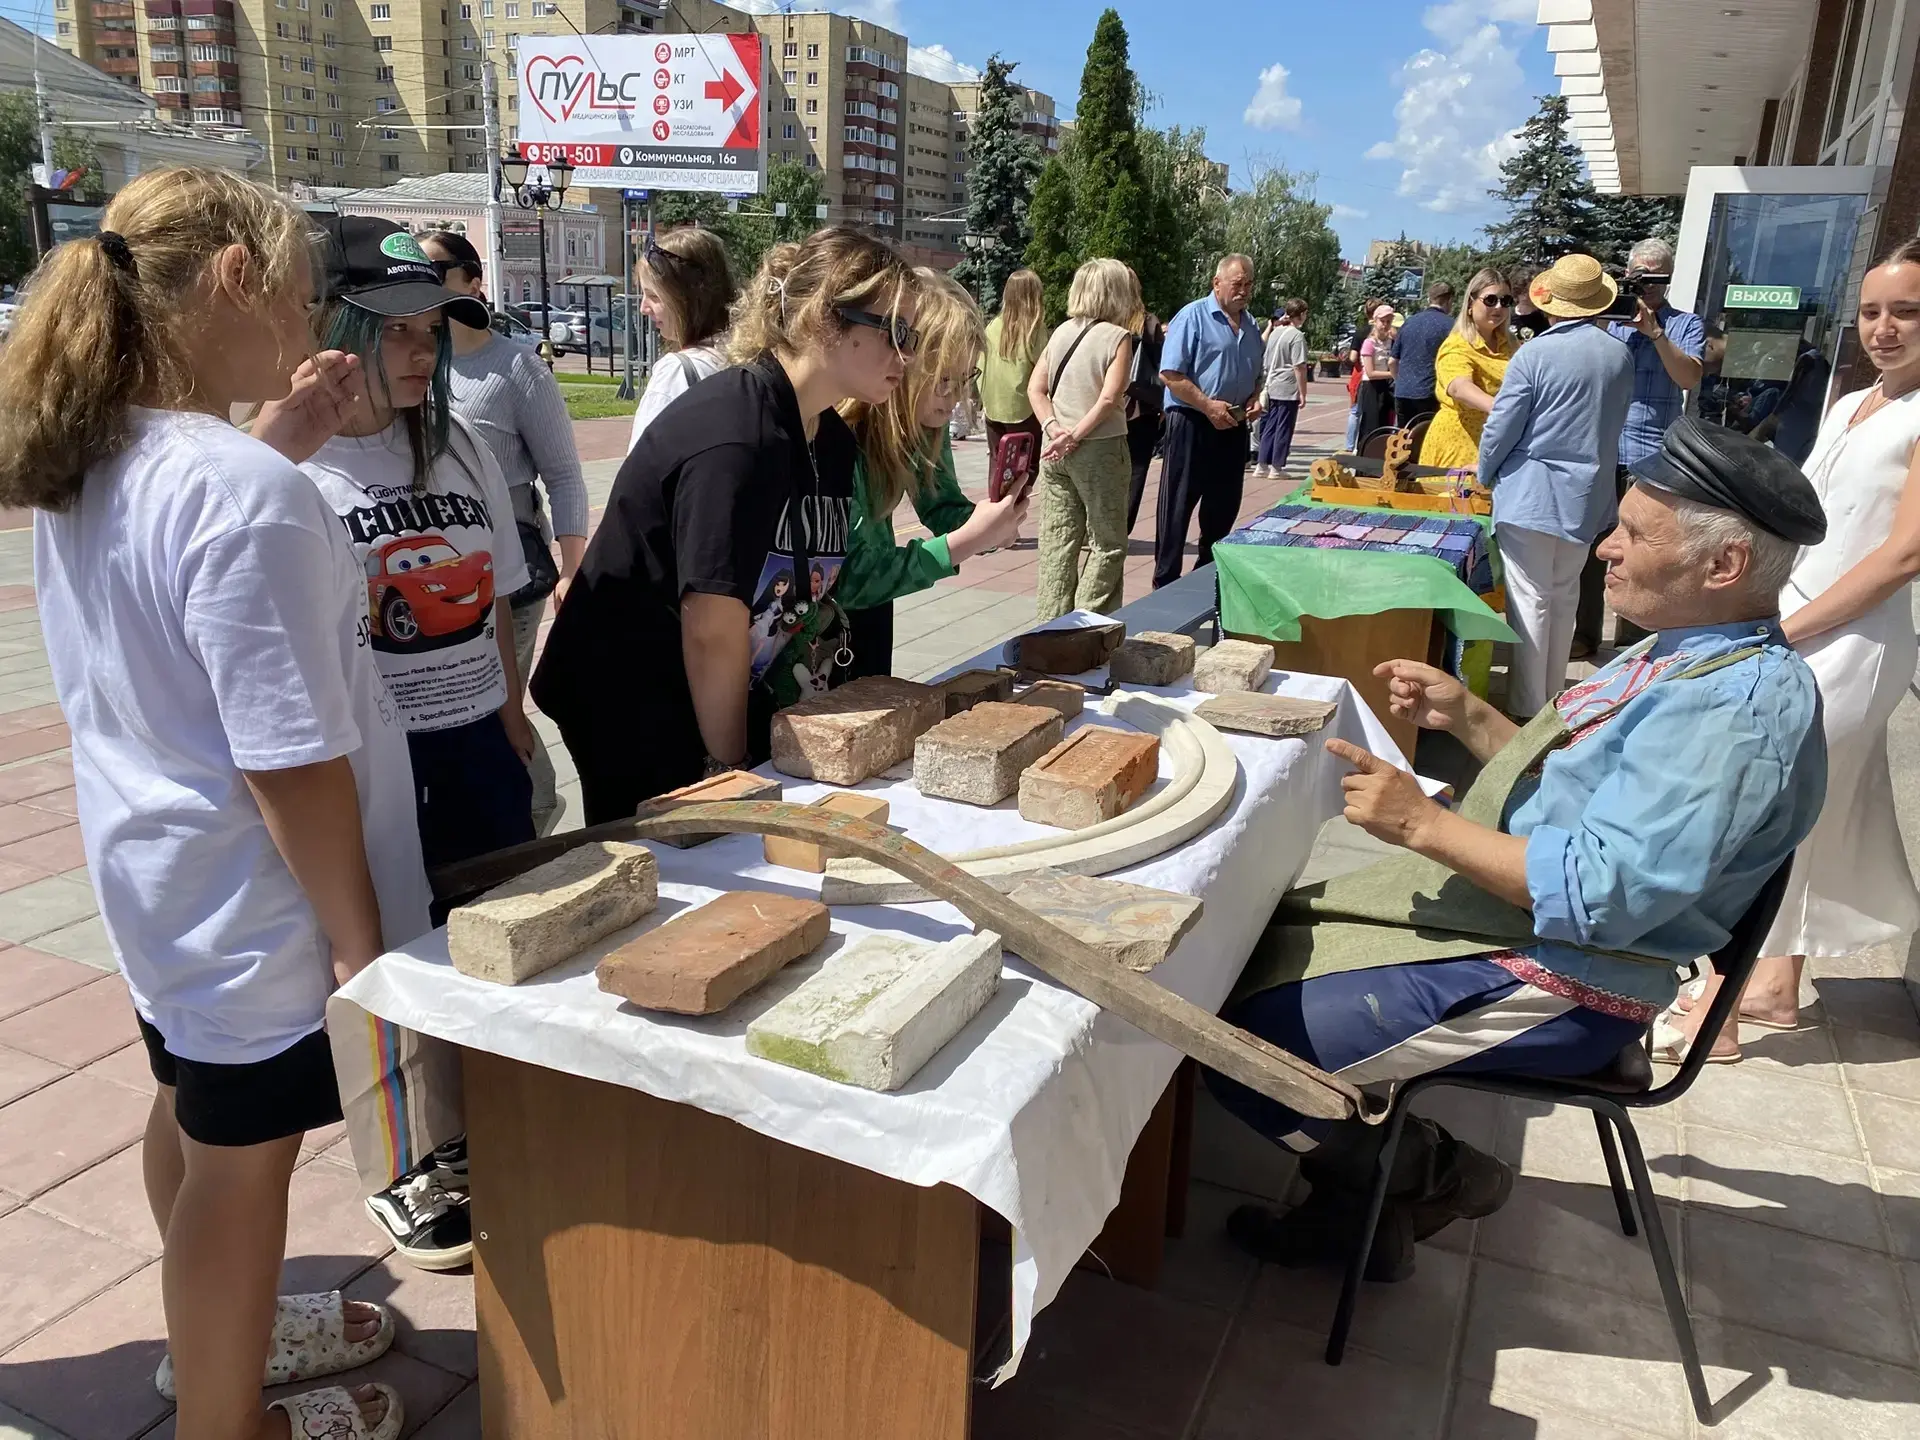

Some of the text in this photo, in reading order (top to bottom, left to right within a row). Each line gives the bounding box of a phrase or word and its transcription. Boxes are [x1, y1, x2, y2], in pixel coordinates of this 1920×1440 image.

[674, 47, 695, 58] МРТ
[674, 74, 685, 84] КТ
[539, 71, 641, 110] ПУЛЬС
[673, 100, 693, 110] УЗИ
[617, 113, 635, 121] ЦЕНТР
[542, 145, 601, 163] 501-501
[635, 150, 737, 165] Коммунальная, 16а
[615, 169, 657, 182] НЕОБХОДИМА
[659, 170, 707, 183] КОНСУЛЬТАЦИЯ
[708, 172, 756, 184] СПЕЦИАЛИСТА
[387, 264, 413, 275] ABOVE
[1732, 290, 1793, 305] ВЫХОД
[372, 483, 427, 499] LIGHTNING
[419, 706, 469, 721] Specifications
